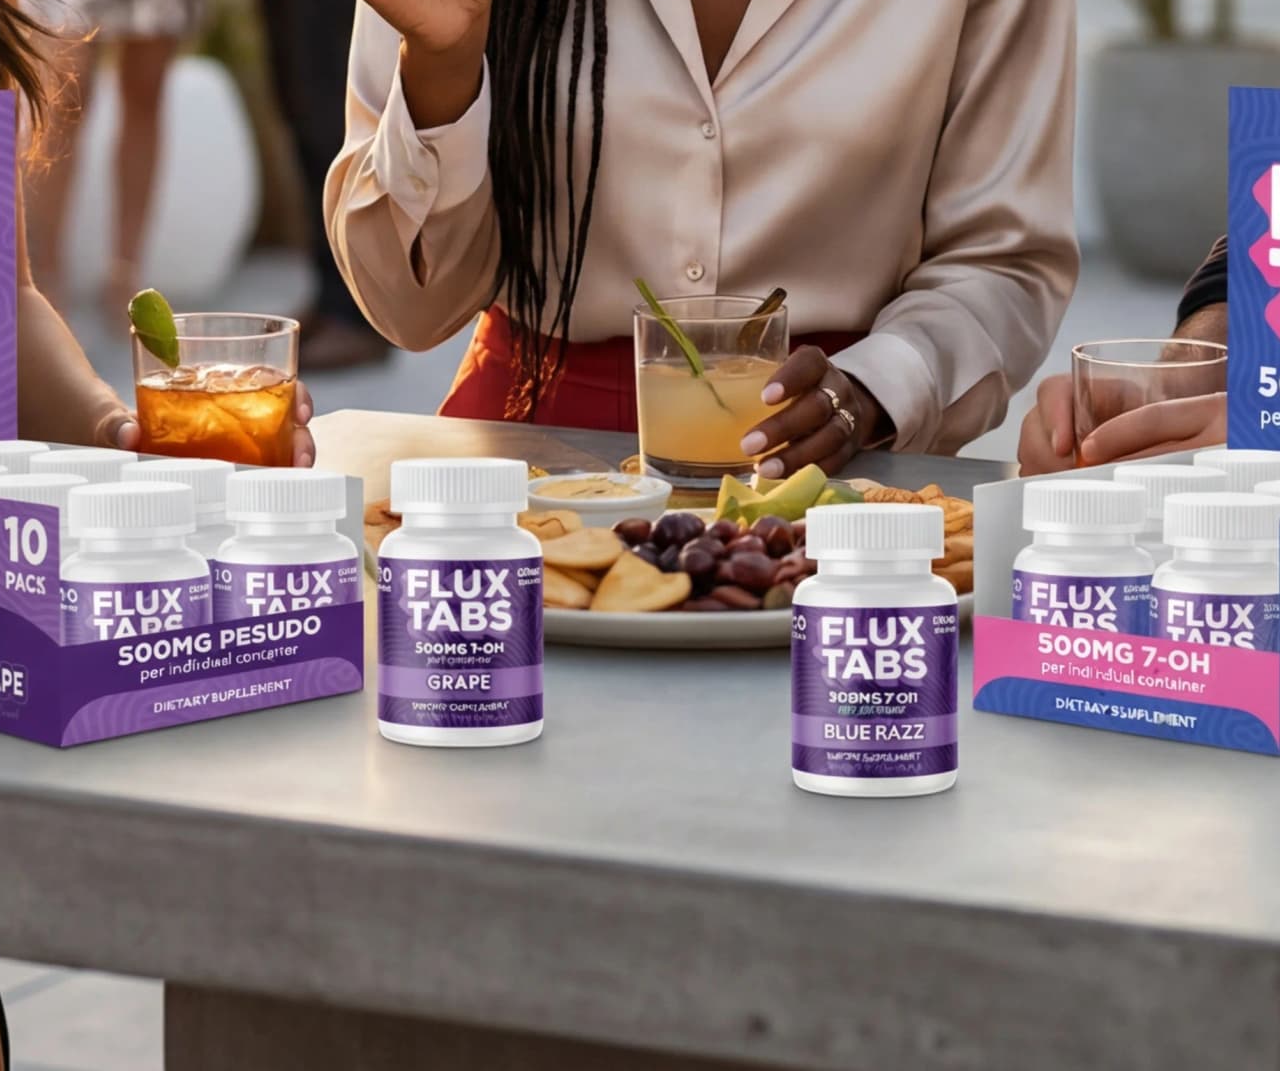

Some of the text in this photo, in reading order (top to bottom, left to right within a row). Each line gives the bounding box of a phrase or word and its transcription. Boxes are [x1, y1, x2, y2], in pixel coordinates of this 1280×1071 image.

[4, 516, 48, 566] 10
[5, 571, 46, 595] PACK
[246, 569, 333, 596] FLUX
[407, 568, 511, 599] FLUX
[1031, 581, 1117, 611] FLUX
[93, 588, 184, 616] FLUX
[408, 600, 512, 632] TABS
[1167, 598, 1255, 629] FLUX
[220, 615, 321, 649] PESUDO
[821, 616, 925, 646] FLUX
[822, 648, 928, 680] TABS
[1038, 632, 1210, 675] 500MG 7-OH
[1041, 662, 1065, 675] per
[140, 669, 165, 684] per
[427, 674, 491, 690] GRAPE
[824, 723, 924, 741] BLUE RAZZ
